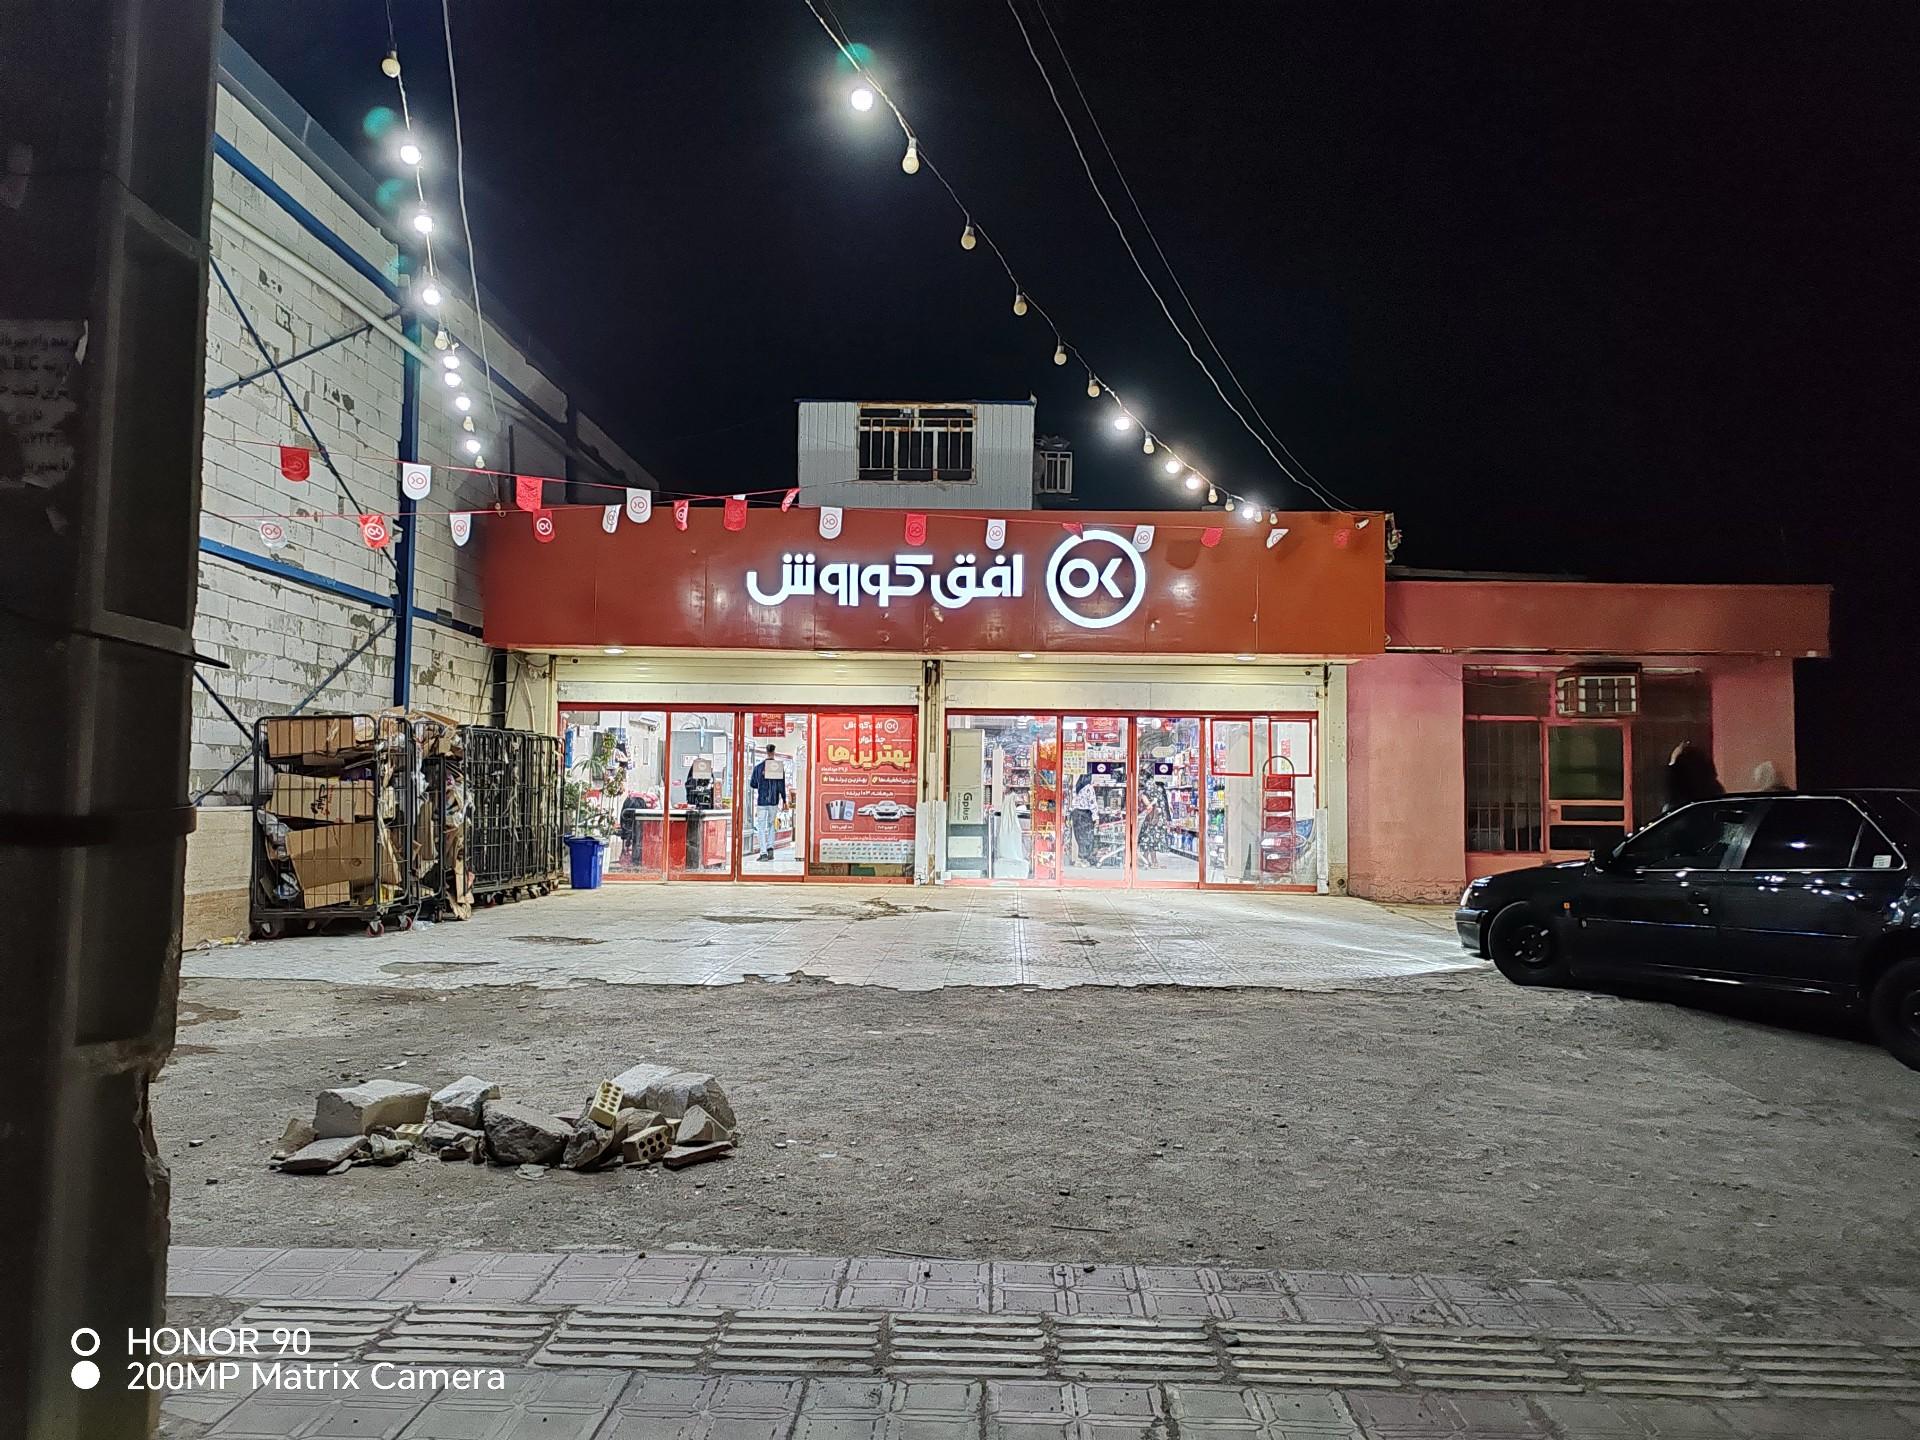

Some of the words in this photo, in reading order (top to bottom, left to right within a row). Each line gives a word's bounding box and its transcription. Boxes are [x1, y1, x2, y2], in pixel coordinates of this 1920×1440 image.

[746, 553, 933, 607] کوروش
[931, 554, 1023, 609] افق
[1059, 558, 1124, 598] OK
[961, 791, 973, 821] Gplus
